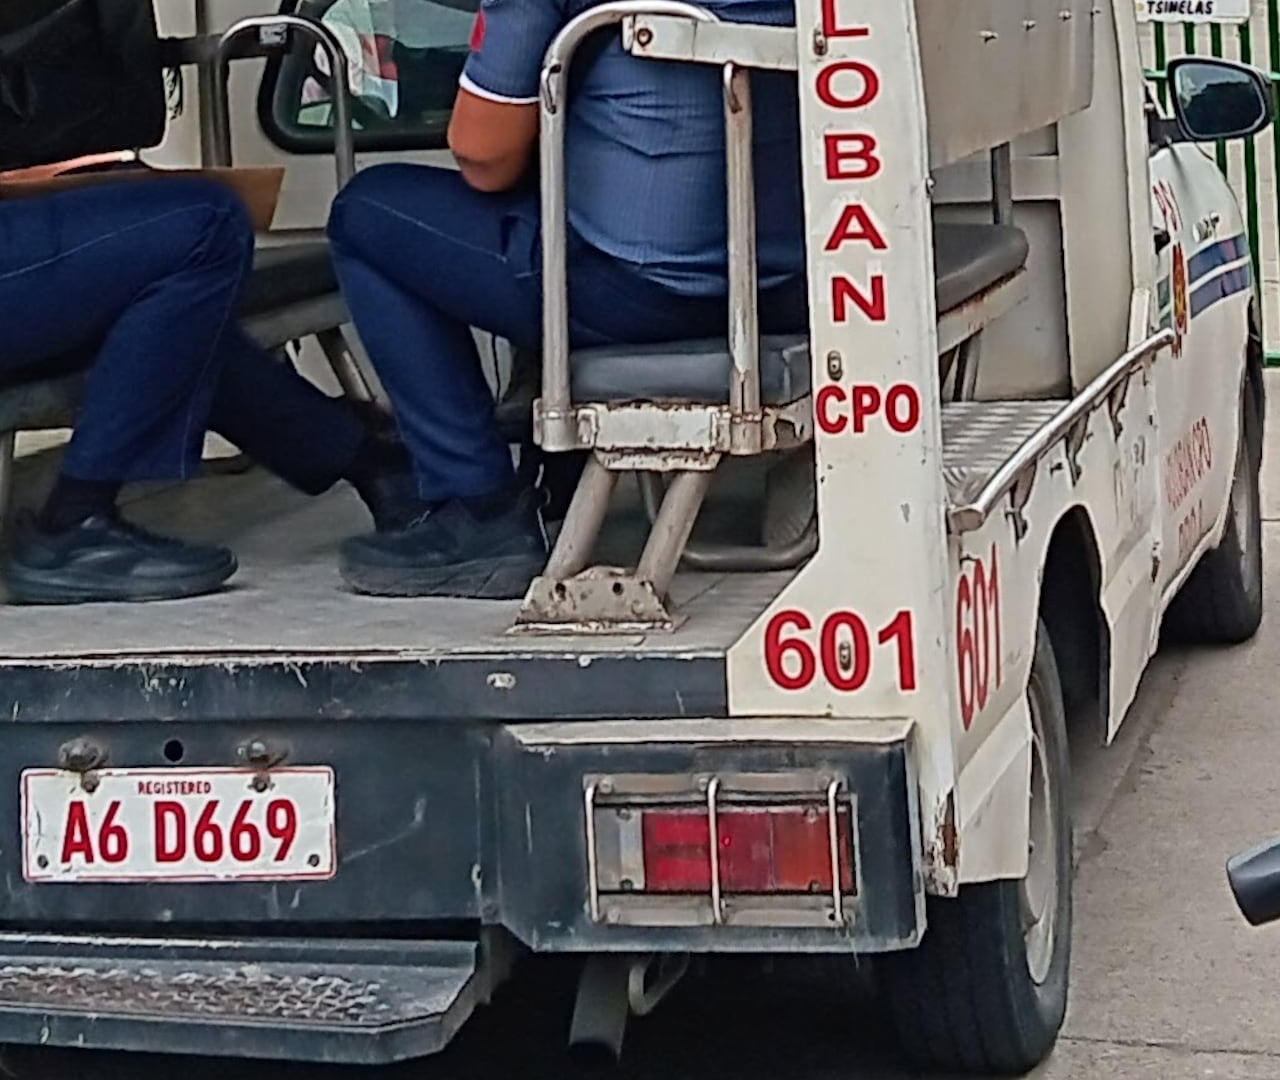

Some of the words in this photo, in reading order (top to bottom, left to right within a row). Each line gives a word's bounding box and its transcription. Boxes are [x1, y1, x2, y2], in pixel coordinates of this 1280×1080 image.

[1147, 1, 1214, 15] TSINELAS
[815, 383, 921, 436] CPO
[764, 610, 916, 692] 601
[956, 542, 1002, 732] 601
[137, 781, 212, 795] REGISTERED
[61, 800, 128, 864] A6
[154, 799, 297, 863] D669
